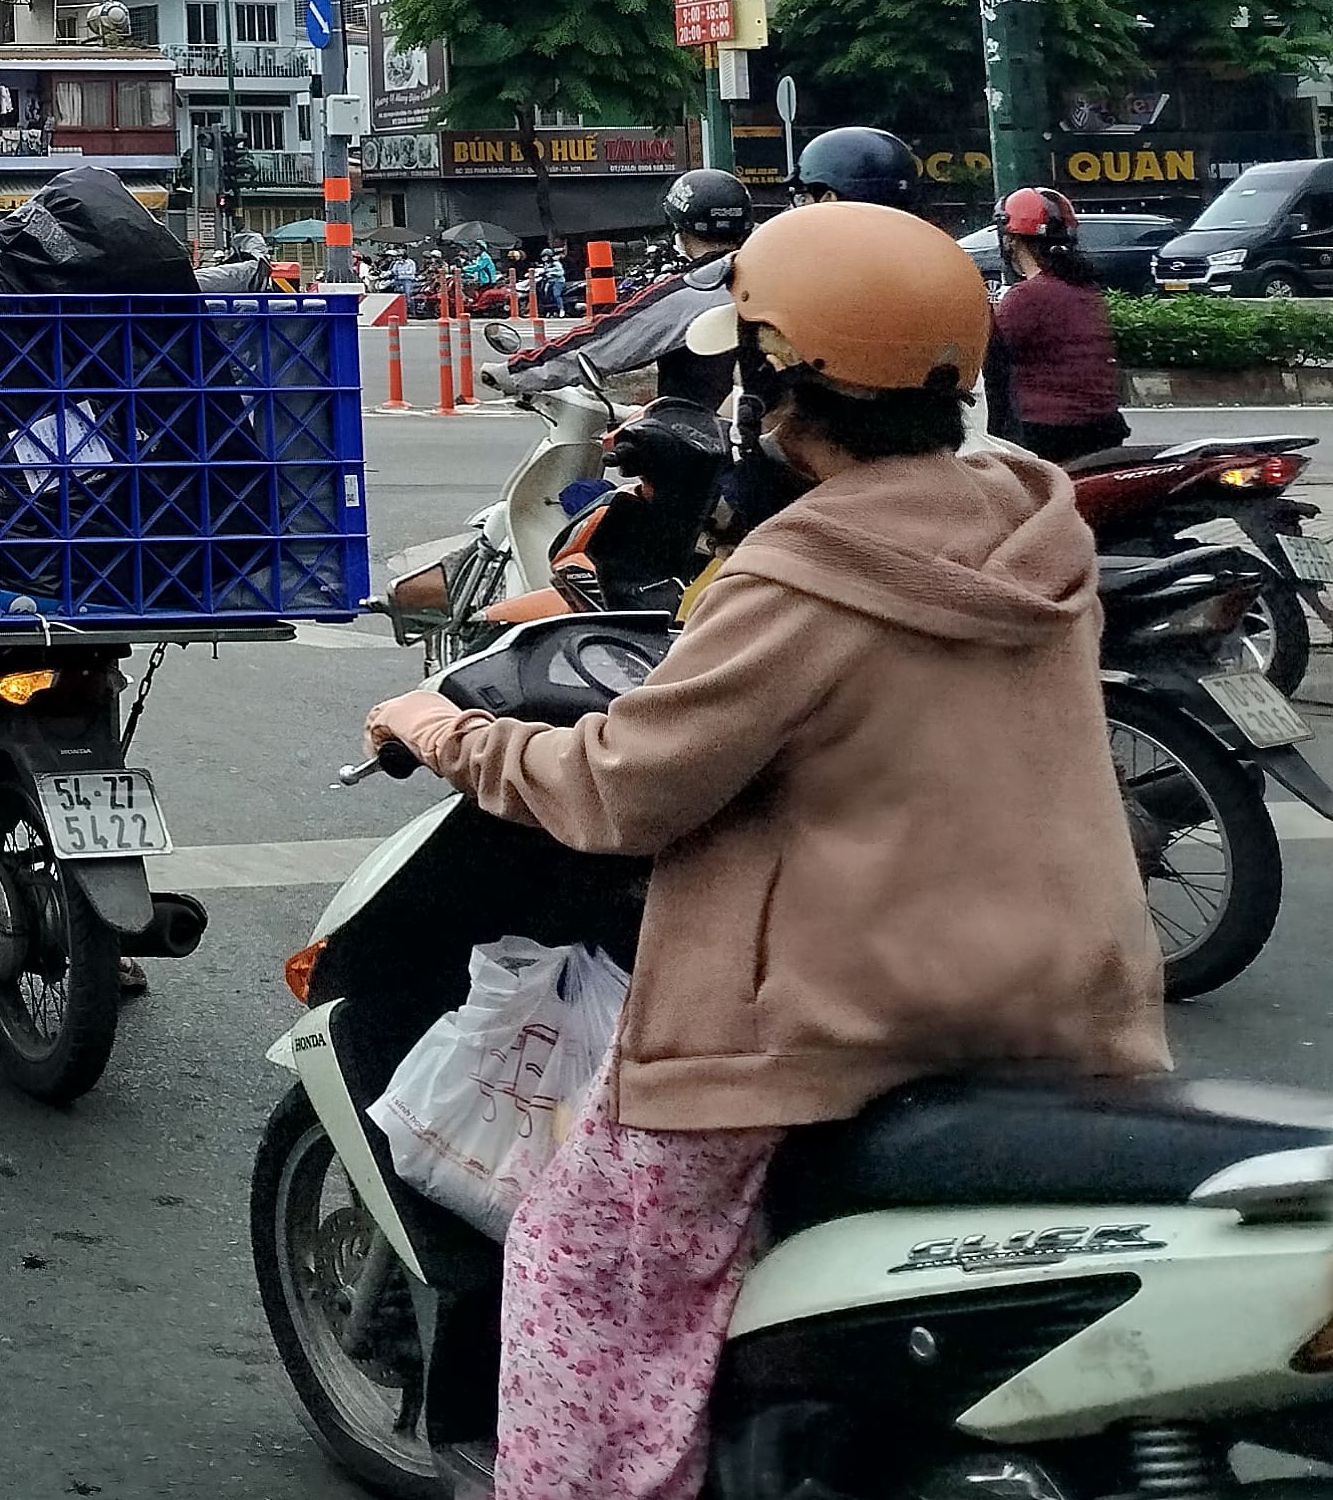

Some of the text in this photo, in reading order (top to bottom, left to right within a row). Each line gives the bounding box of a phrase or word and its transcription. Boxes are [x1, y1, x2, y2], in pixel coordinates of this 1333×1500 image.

[710, 21, 729, 38] 6:00
[453, 132, 599, 163] BÚN HUẾ
[65, 814, 154, 850] 5422
[294, 1033, 327, 1052] HONDA
